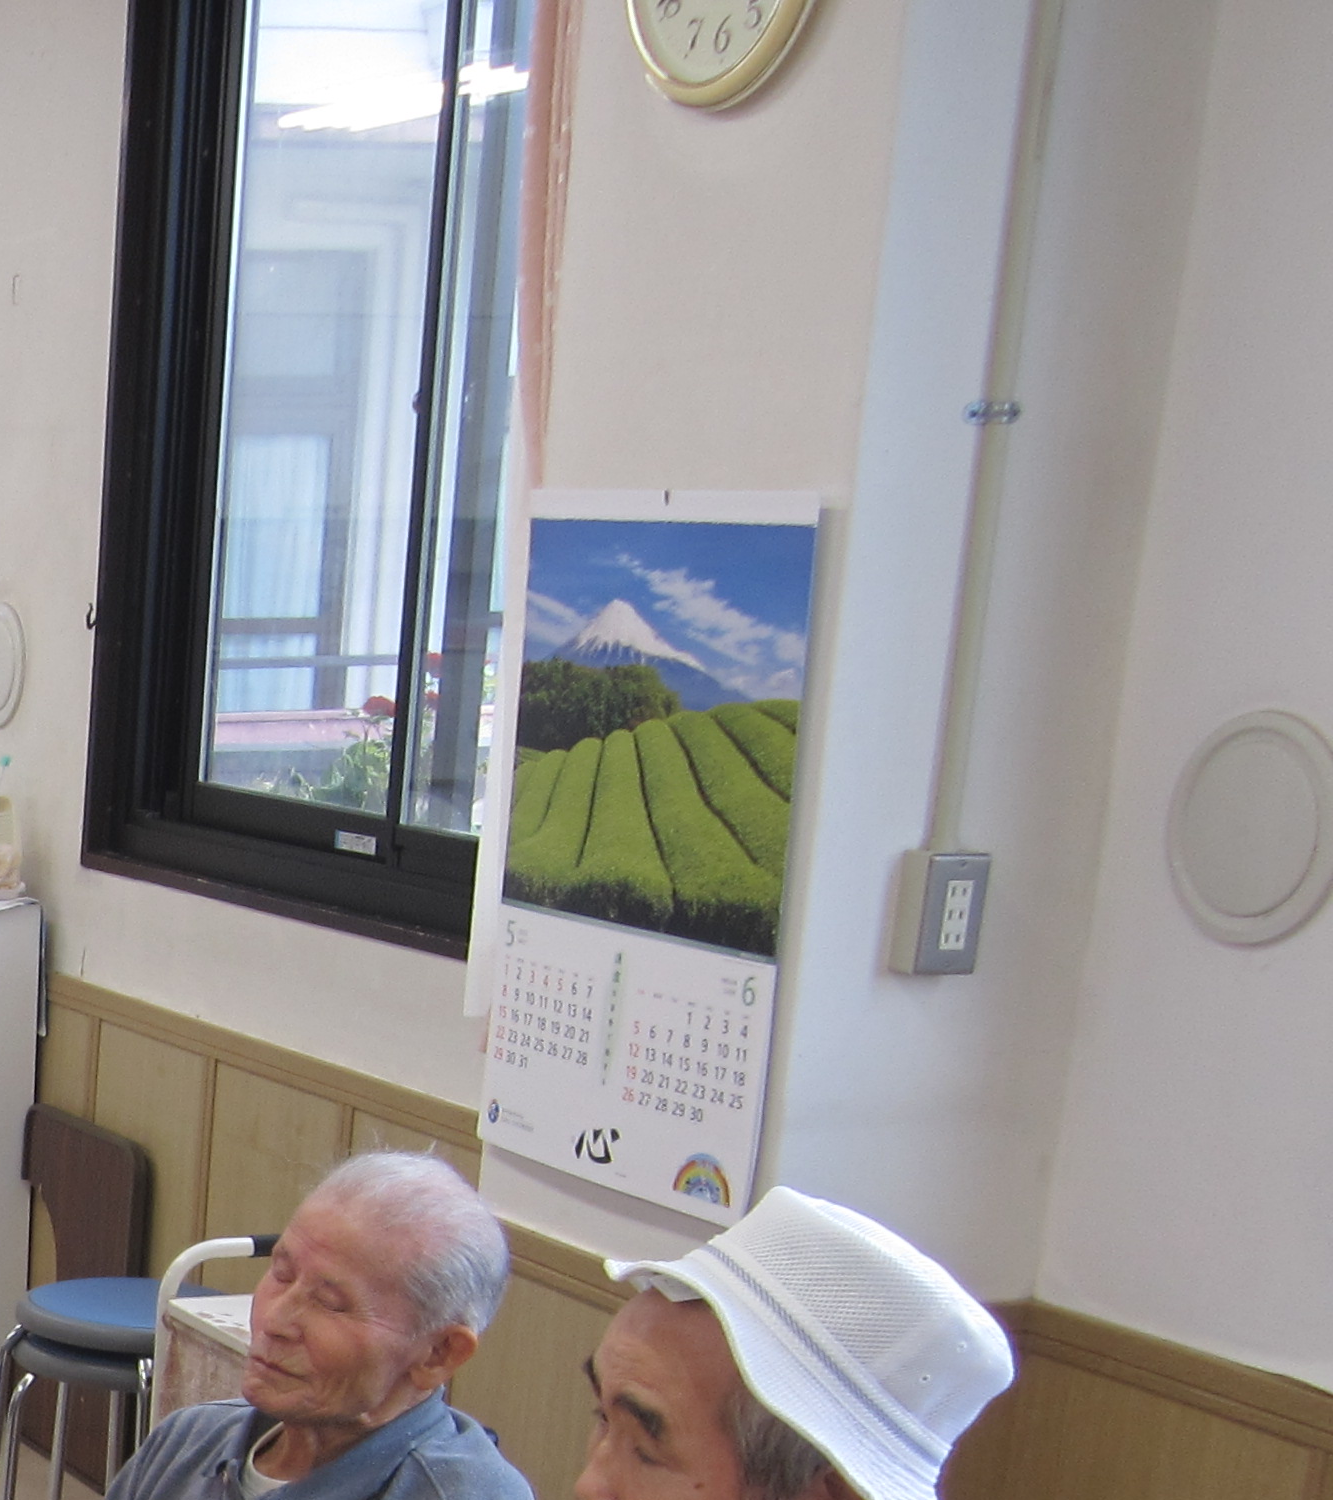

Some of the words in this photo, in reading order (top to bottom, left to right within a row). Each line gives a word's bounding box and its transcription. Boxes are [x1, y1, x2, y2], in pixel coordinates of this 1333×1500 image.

[744, 0, 763, 29] 5
[713, 15, 732, 54] 6
[506, 920, 516, 946] 5
[505, 964, 509, 975] 1
[516, 967, 522, 980] 2
[530, 970, 535, 983] 3
[543, 975, 548, 987] 4
[557, 978, 563, 991] 5
[571, 982, 577, 995] 6
[587, 986, 593, 998] 7
[742, 977, 755, 1006] 6
[502, 985, 507, 996] 8
[514, 988, 519, 1001] 9
[526, 992, 535, 1005] 10
[539, 996, 548, 1009] 11
[553, 1000, 563, 1013] 12
[568, 1004, 577, 1017] 13
[583, 1008, 592, 1021] 14
[499, 1005, 507, 1018] 15
[511, 1009, 519, 1023] 16
[524, 1013, 532, 1025] 17
[538, 1017, 546, 1031] 18
[551, 1021, 560, 1034] 19
[564, 1025, 575, 1039] 20
[579, 1029, 589, 1043] 21
[634, 1021, 640, 1034] 5
[649, 1026, 656, 1038] 6
[667, 1029, 673, 1042] 7
[683, 1034, 690, 1048] 8
[701, 1039, 708, 1052] 9
[718, 1044, 729, 1058] 10
[736, 1048, 747, 1062] 11
[687, 1012, 692, 1024] 1
[704, 1016, 711, 1029] 2
[722, 1020, 729, 1034] 3
[741, 1025, 748, 1038] 4
[494, 1046, 503, 1059] 29
[506, 1050, 516, 1064] 30
[519, 1055, 527, 1068] 31
[496, 1025, 505, 1039] 22
[508, 1029, 518, 1043] 23
[520, 1034, 530, 1048] 24
[534, 1038, 544, 1052] 25
[547, 1042, 558, 1056] 26
[561, 1046, 573, 1060] 27
[576, 1050, 587, 1065] 28
[629, 1043, 639, 1057] 12
[646, 1048, 656, 1062] 13
[662, 1052, 673, 1066] 14
[679, 1057, 690, 1071] 15
[697, 1062, 707, 1076] 16
[715, 1066, 727, 1080] 17
[733, 1071, 745, 1086] 18
[622, 1087, 634, 1102] 26
[638, 1092, 651, 1106] 27
[655, 1097, 668, 1112] 28
[672, 1102, 685, 1116] 29
[690, 1107, 703, 1122] 30
[627, 1066, 637, 1079] 19
[641, 1069, 654, 1084] 20
[658, 1074, 669, 1088] 21
[675, 1079, 688, 1094] 22
[693, 1084, 705, 1099] 23
[711, 1089, 724, 1104] 24
[729, 1094, 743, 1109] 25
[574, 1128, 621, 1164] 心
